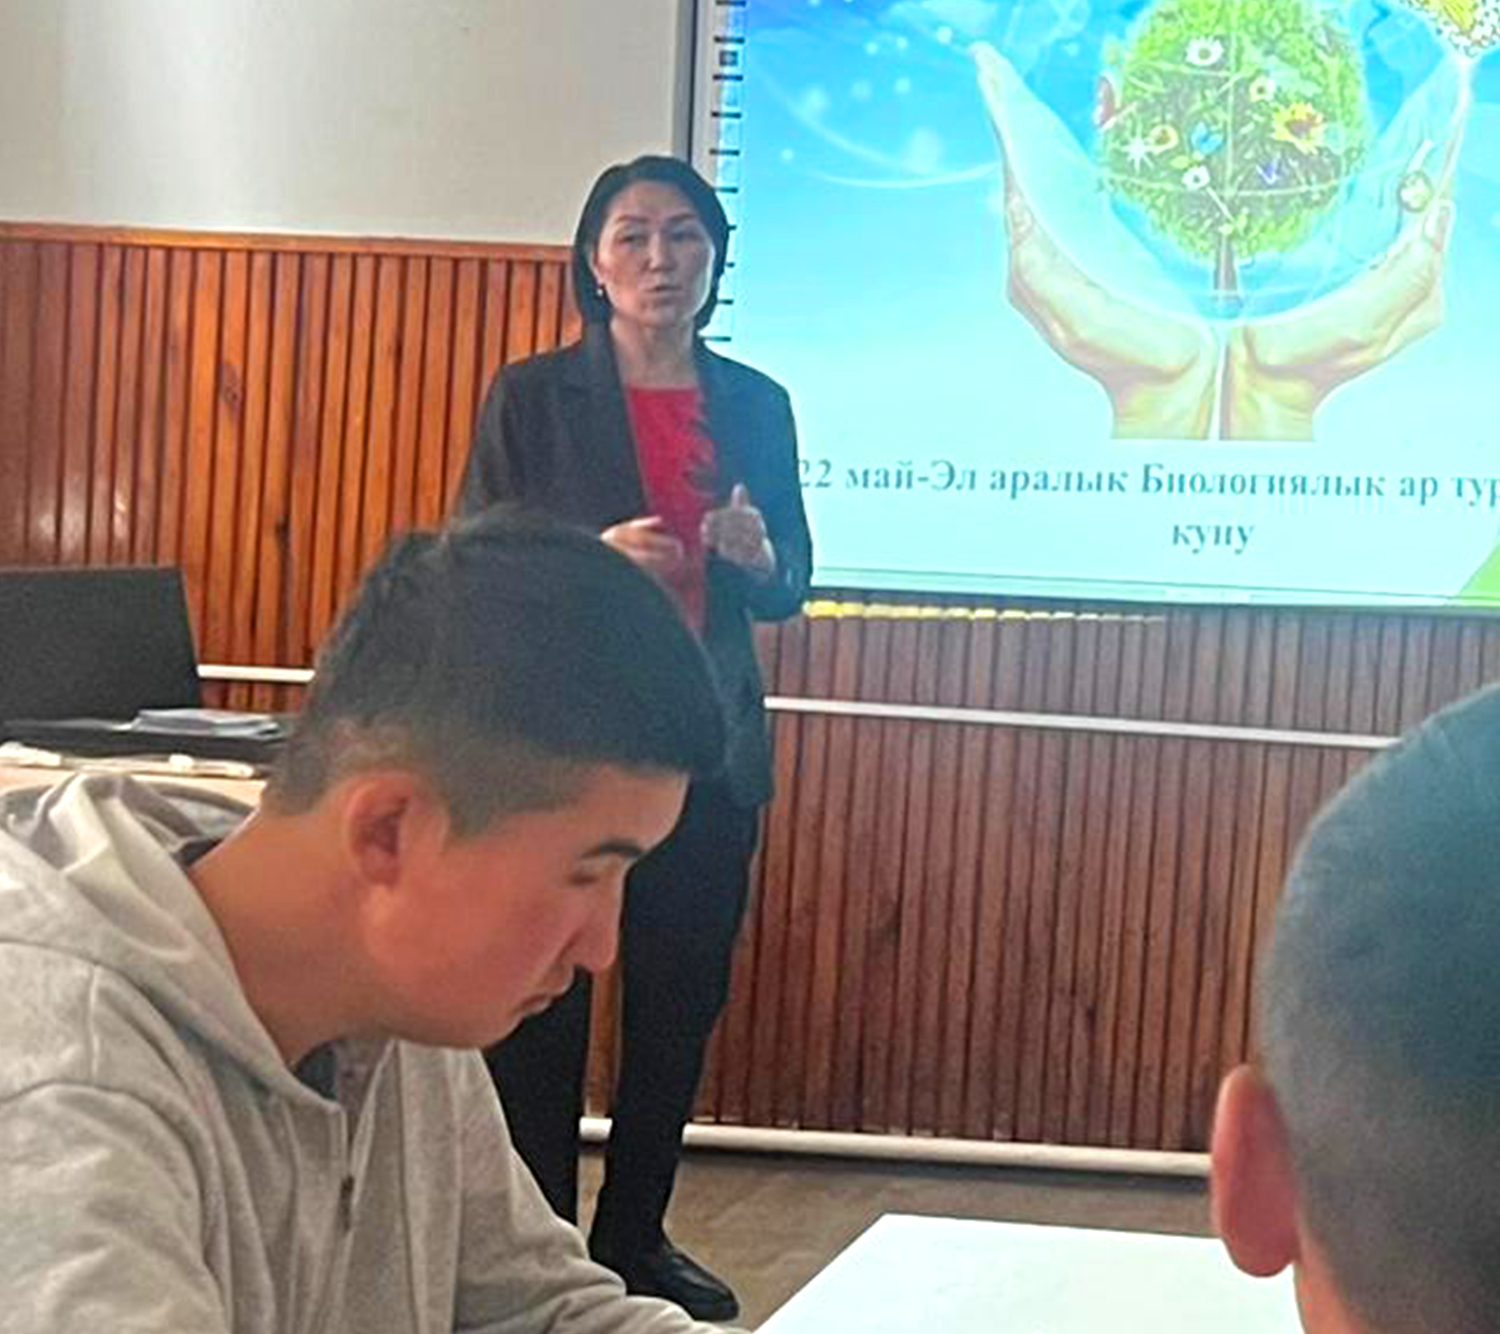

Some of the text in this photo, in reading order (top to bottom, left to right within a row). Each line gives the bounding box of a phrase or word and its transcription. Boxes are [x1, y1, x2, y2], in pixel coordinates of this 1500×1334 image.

[845, 458, 977, 493] май-Эл
[989, 466, 1128, 498] аралык
[1141, 463, 1387, 498] Биологиялык
[1399, 475, 1438, 506] ар
[1170, 520, 1256, 555] куну
